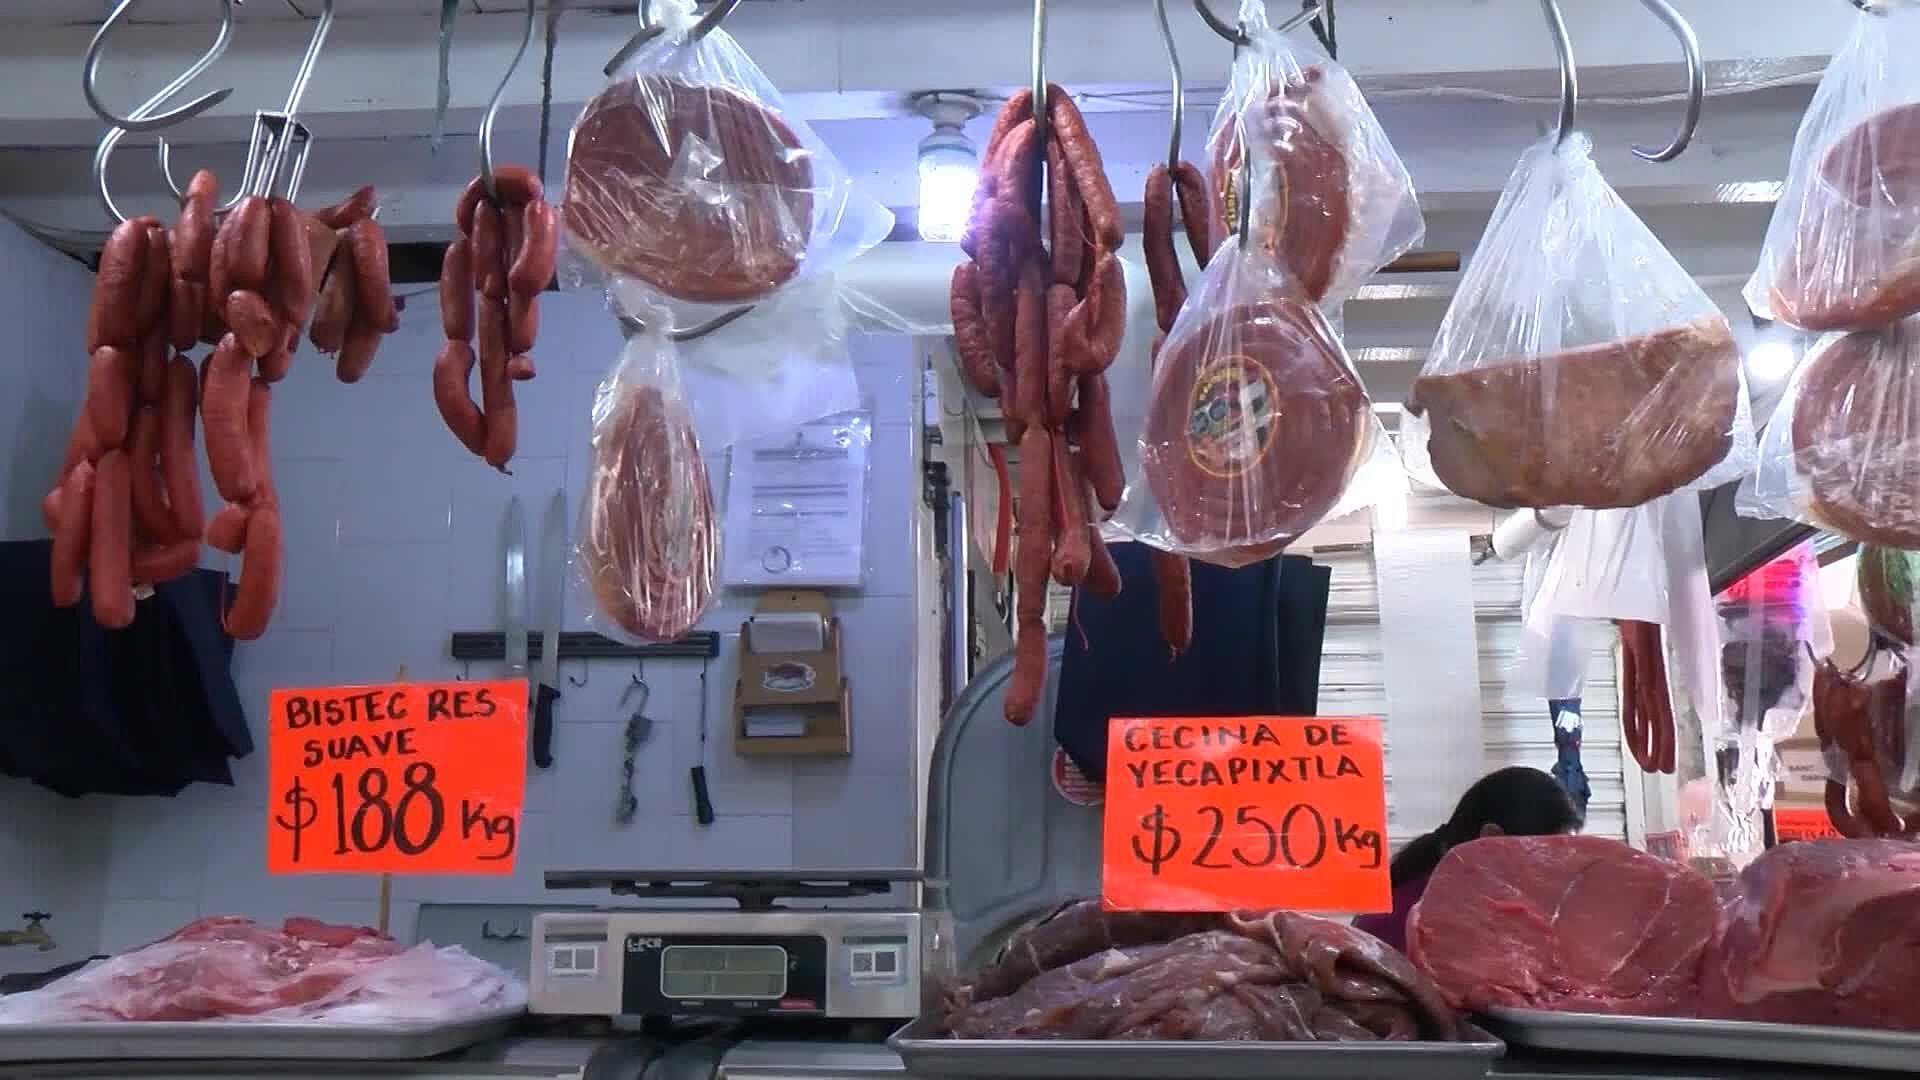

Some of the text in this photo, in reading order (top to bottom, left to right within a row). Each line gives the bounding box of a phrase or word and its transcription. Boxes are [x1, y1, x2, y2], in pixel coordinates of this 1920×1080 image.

[285, 688, 497, 729] BISTEC RES
[303, 727, 419, 768] SUAVE
[1124, 723, 1353, 753] CECINA DE
[1126, 754, 1364, 789] YECAPIXTLA
